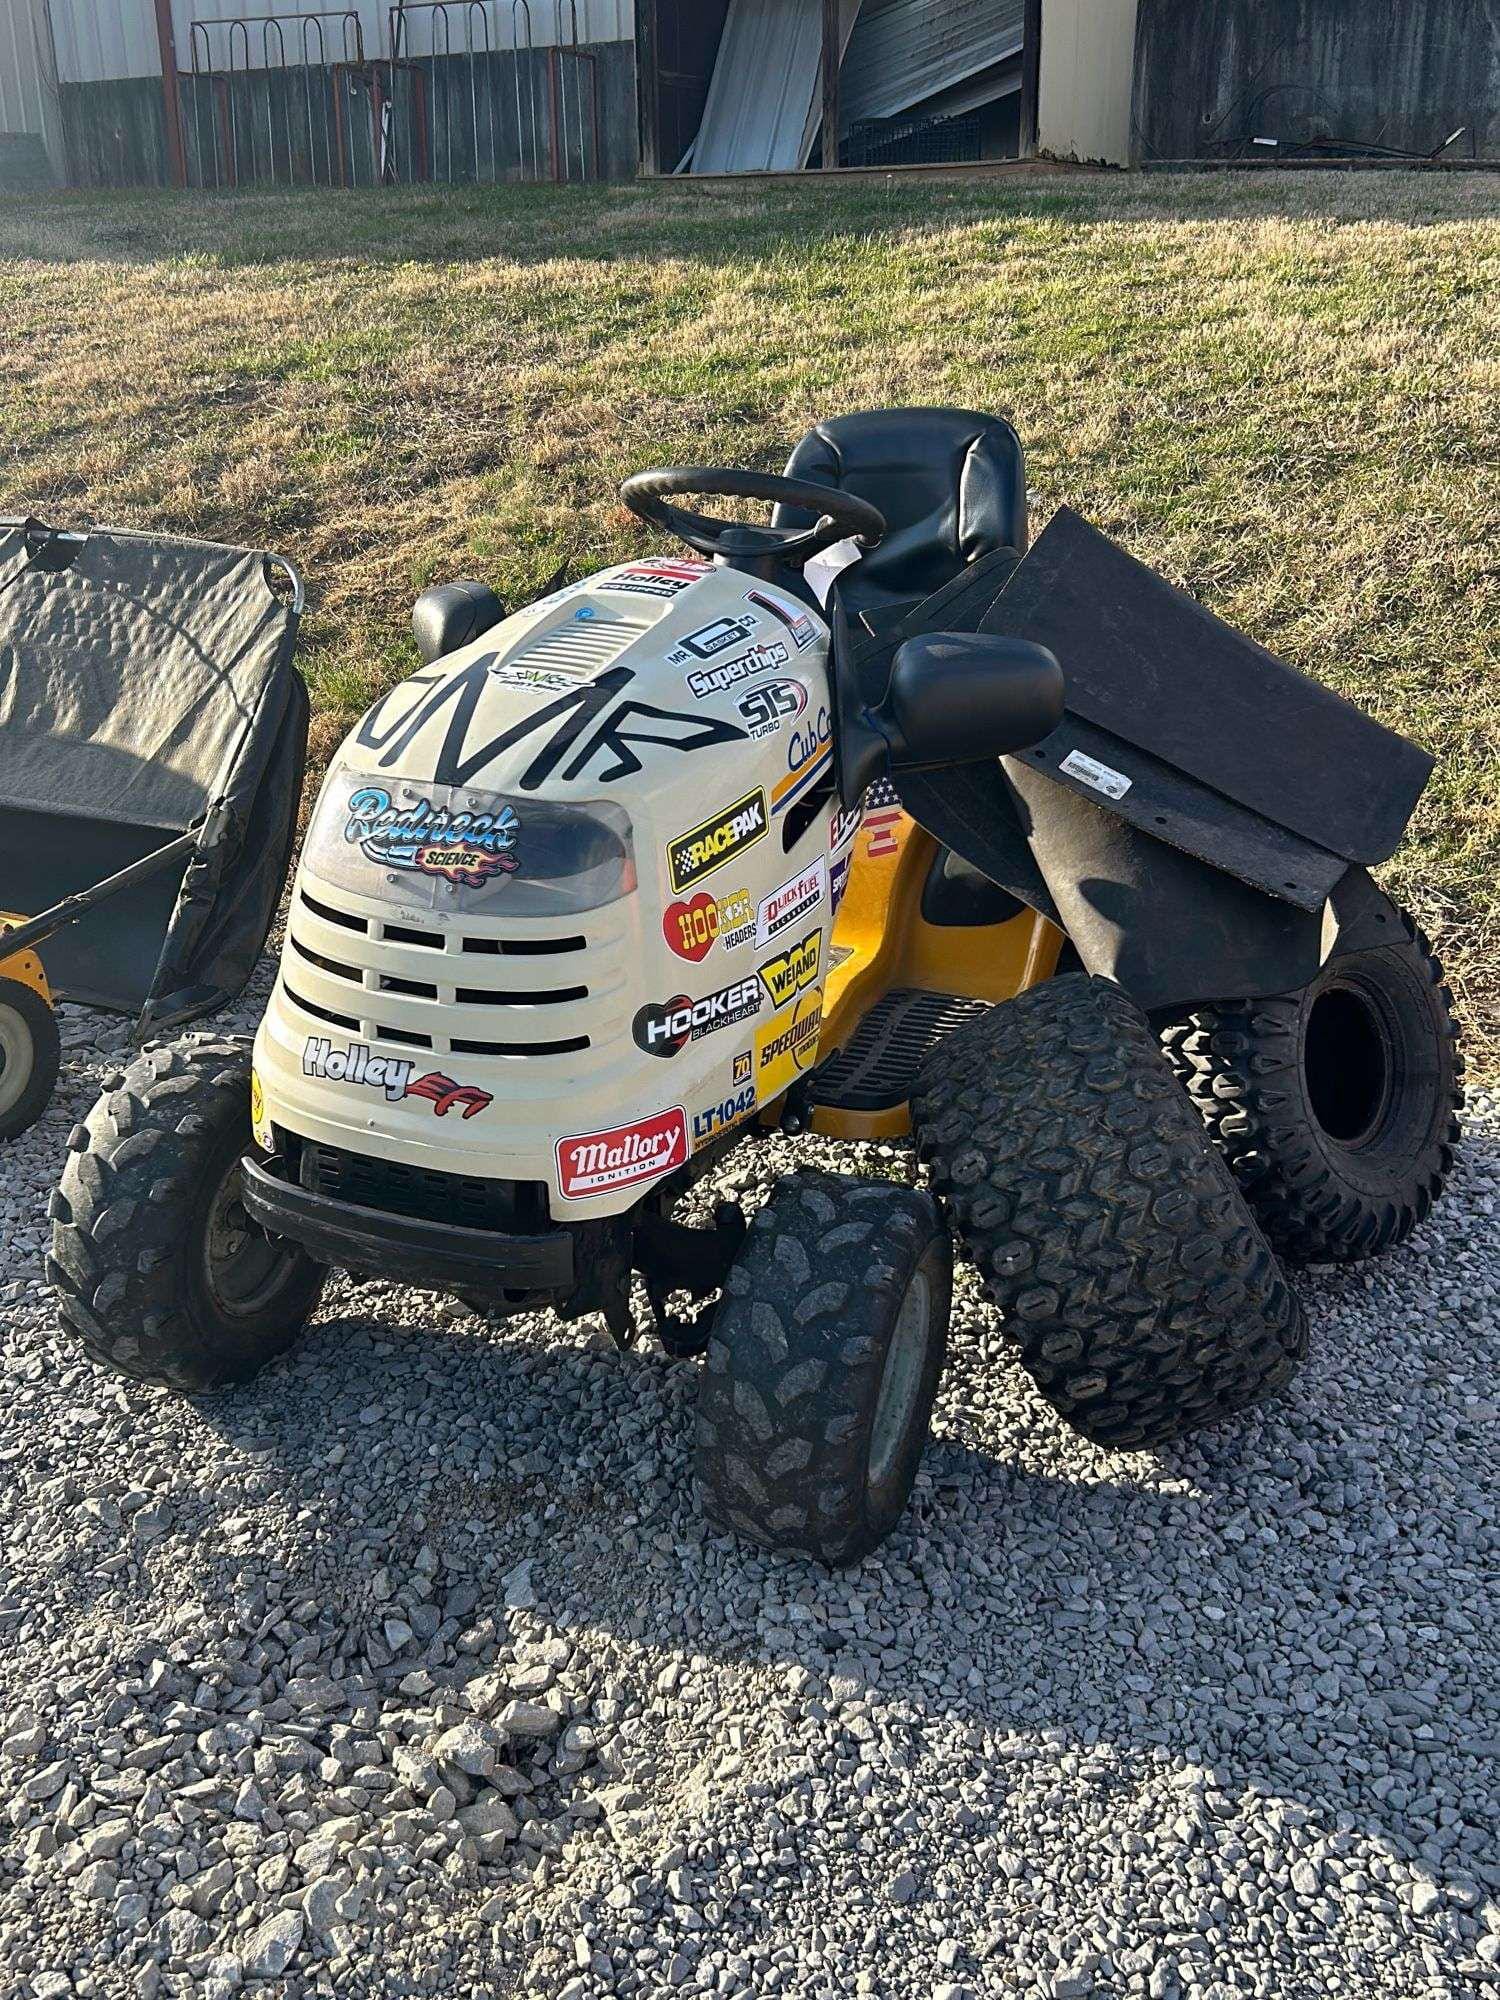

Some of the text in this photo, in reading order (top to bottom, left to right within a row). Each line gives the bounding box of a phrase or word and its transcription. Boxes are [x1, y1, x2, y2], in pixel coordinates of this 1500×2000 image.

[612, 573, 691, 590] Holley
[667, 650, 693, 665] MR.
[705, 631, 740, 651] GASKET
[688, 642, 789, 699] Superchips
[739, 683, 798, 730] STS
[750, 721, 781, 740] TURBO
[788, 720, 818, 772] Cub
[345, 787, 521, 851] Redneck
[688, 802, 765, 869] RACEPAK
[425, 850, 480, 867] SCIENCE
[678, 887, 755, 950] HOOKER
[724, 921, 758, 950] HEADERS
[771, 948, 817, 993] WEIAND
[647, 977, 760, 1044] HOOKER
[692, 1002, 761, 1039] BLACKHEART
[303, 1036, 416, 1102] Holley
[734, 1056, 751, 1079] 70
[693, 1085, 756, 1138] LT1042
[569, 1124, 681, 1176] Mallory
[589, 1158, 657, 1185] IGNITION
